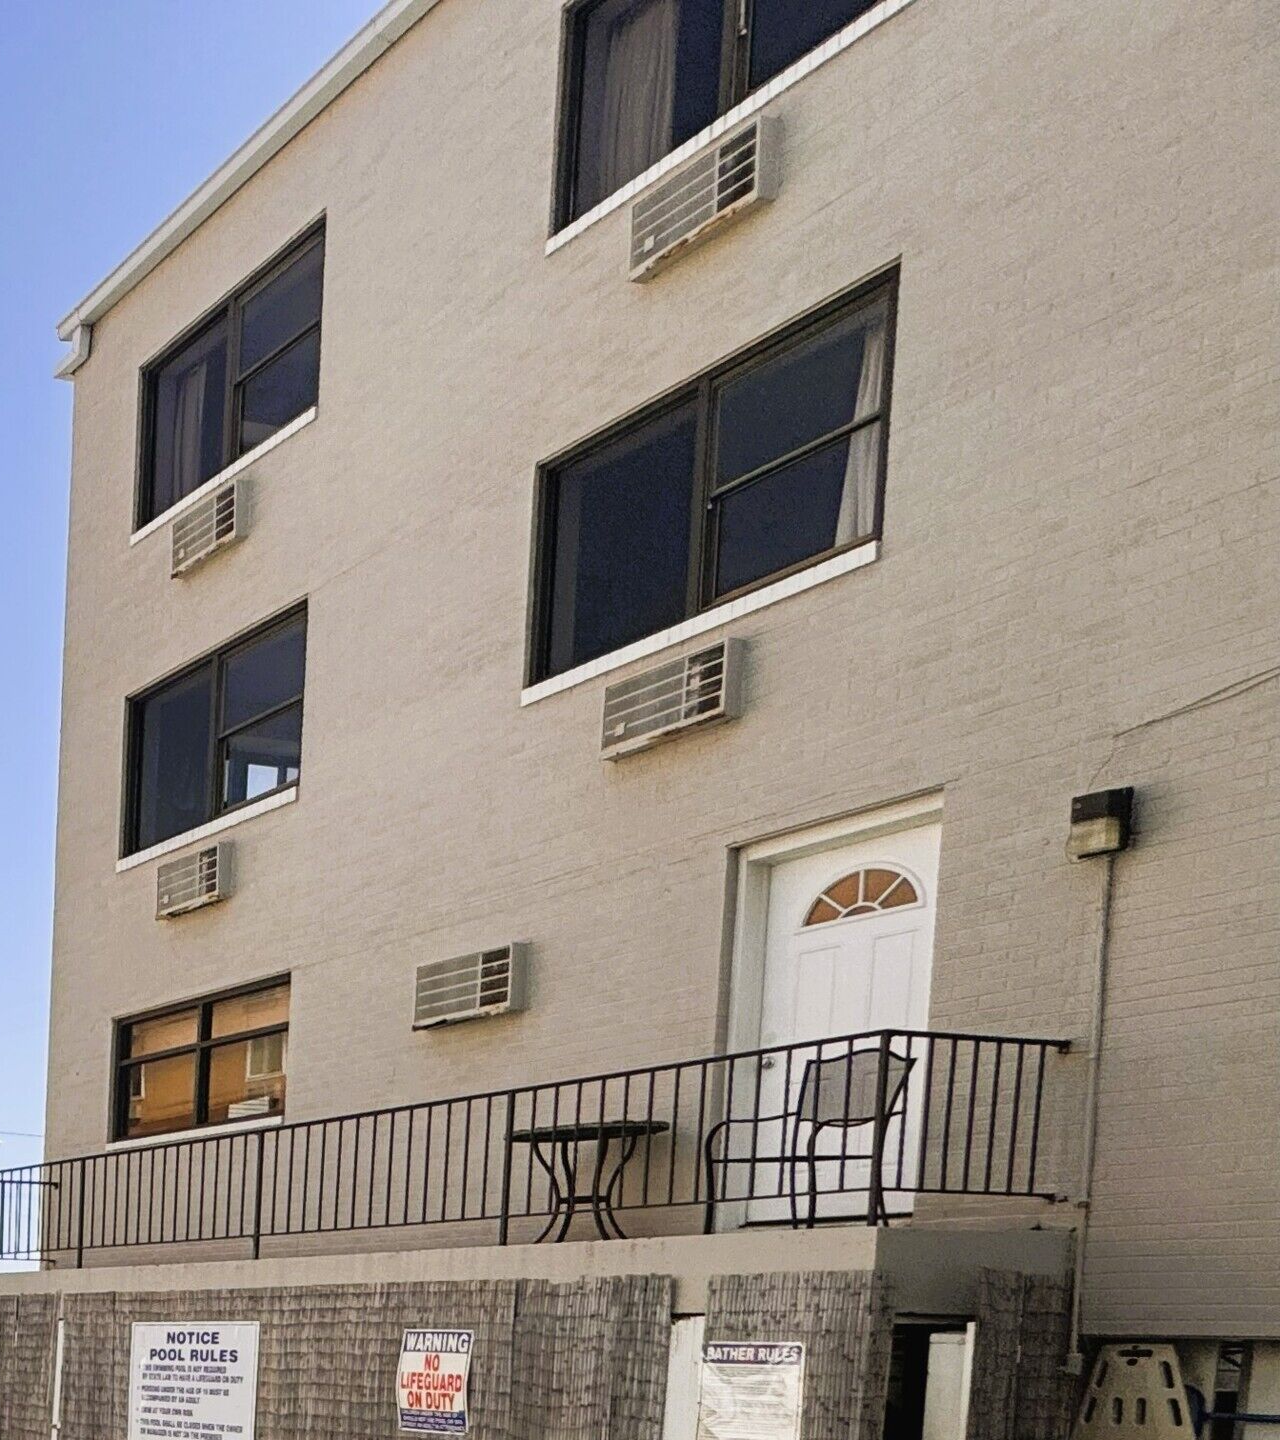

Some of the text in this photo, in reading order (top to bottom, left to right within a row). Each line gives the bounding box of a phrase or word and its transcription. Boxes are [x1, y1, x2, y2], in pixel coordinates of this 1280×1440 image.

[166, 1331, 220, 1344] NOTICE
[406, 1332, 469, 1352] WARNING
[150, 1349, 238, 1363] POOL RULES
[424, 1353, 440, 1372] NO
[706, 1346, 799, 1363] BATHER RULES
[400, 1371, 462, 1393] LIFEGUARD
[407, 1390, 455, 1410] ON DUTY
